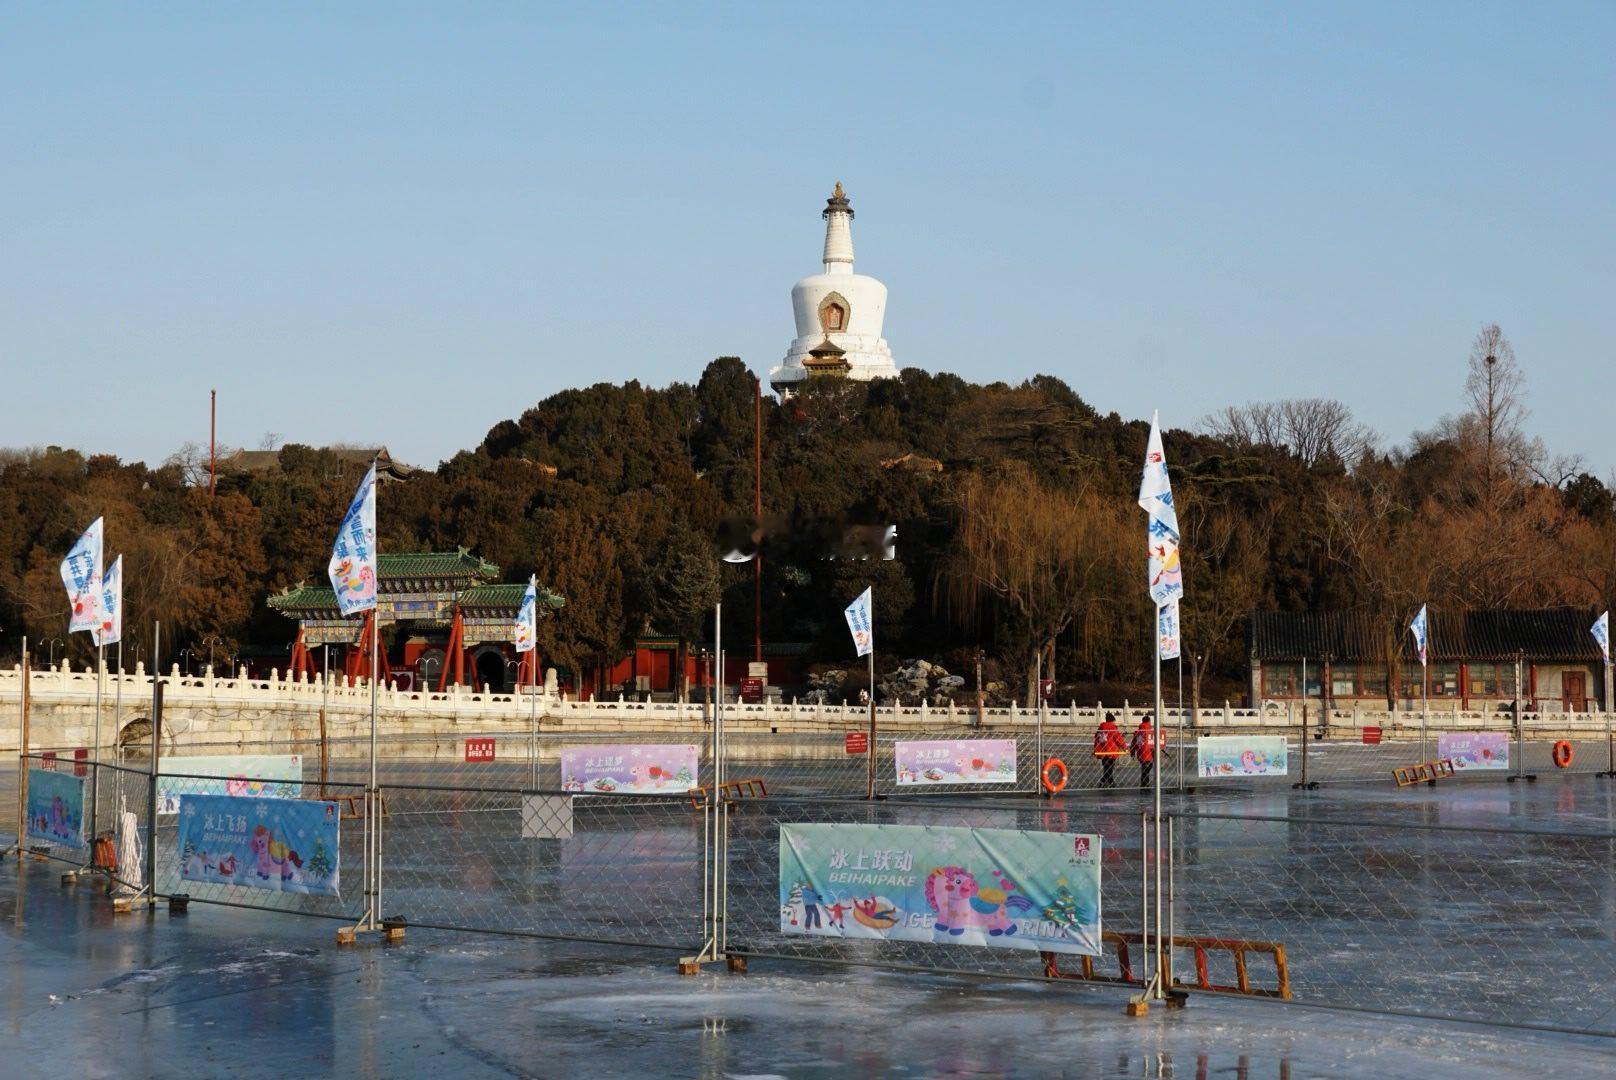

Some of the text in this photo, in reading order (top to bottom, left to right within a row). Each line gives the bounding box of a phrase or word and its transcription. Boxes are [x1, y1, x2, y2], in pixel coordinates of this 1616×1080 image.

[828, 847, 914, 872] 冰上跃动
[828, 872, 917, 887] BEIHAIPAKE
[902, 911, 934, 929] ICE
